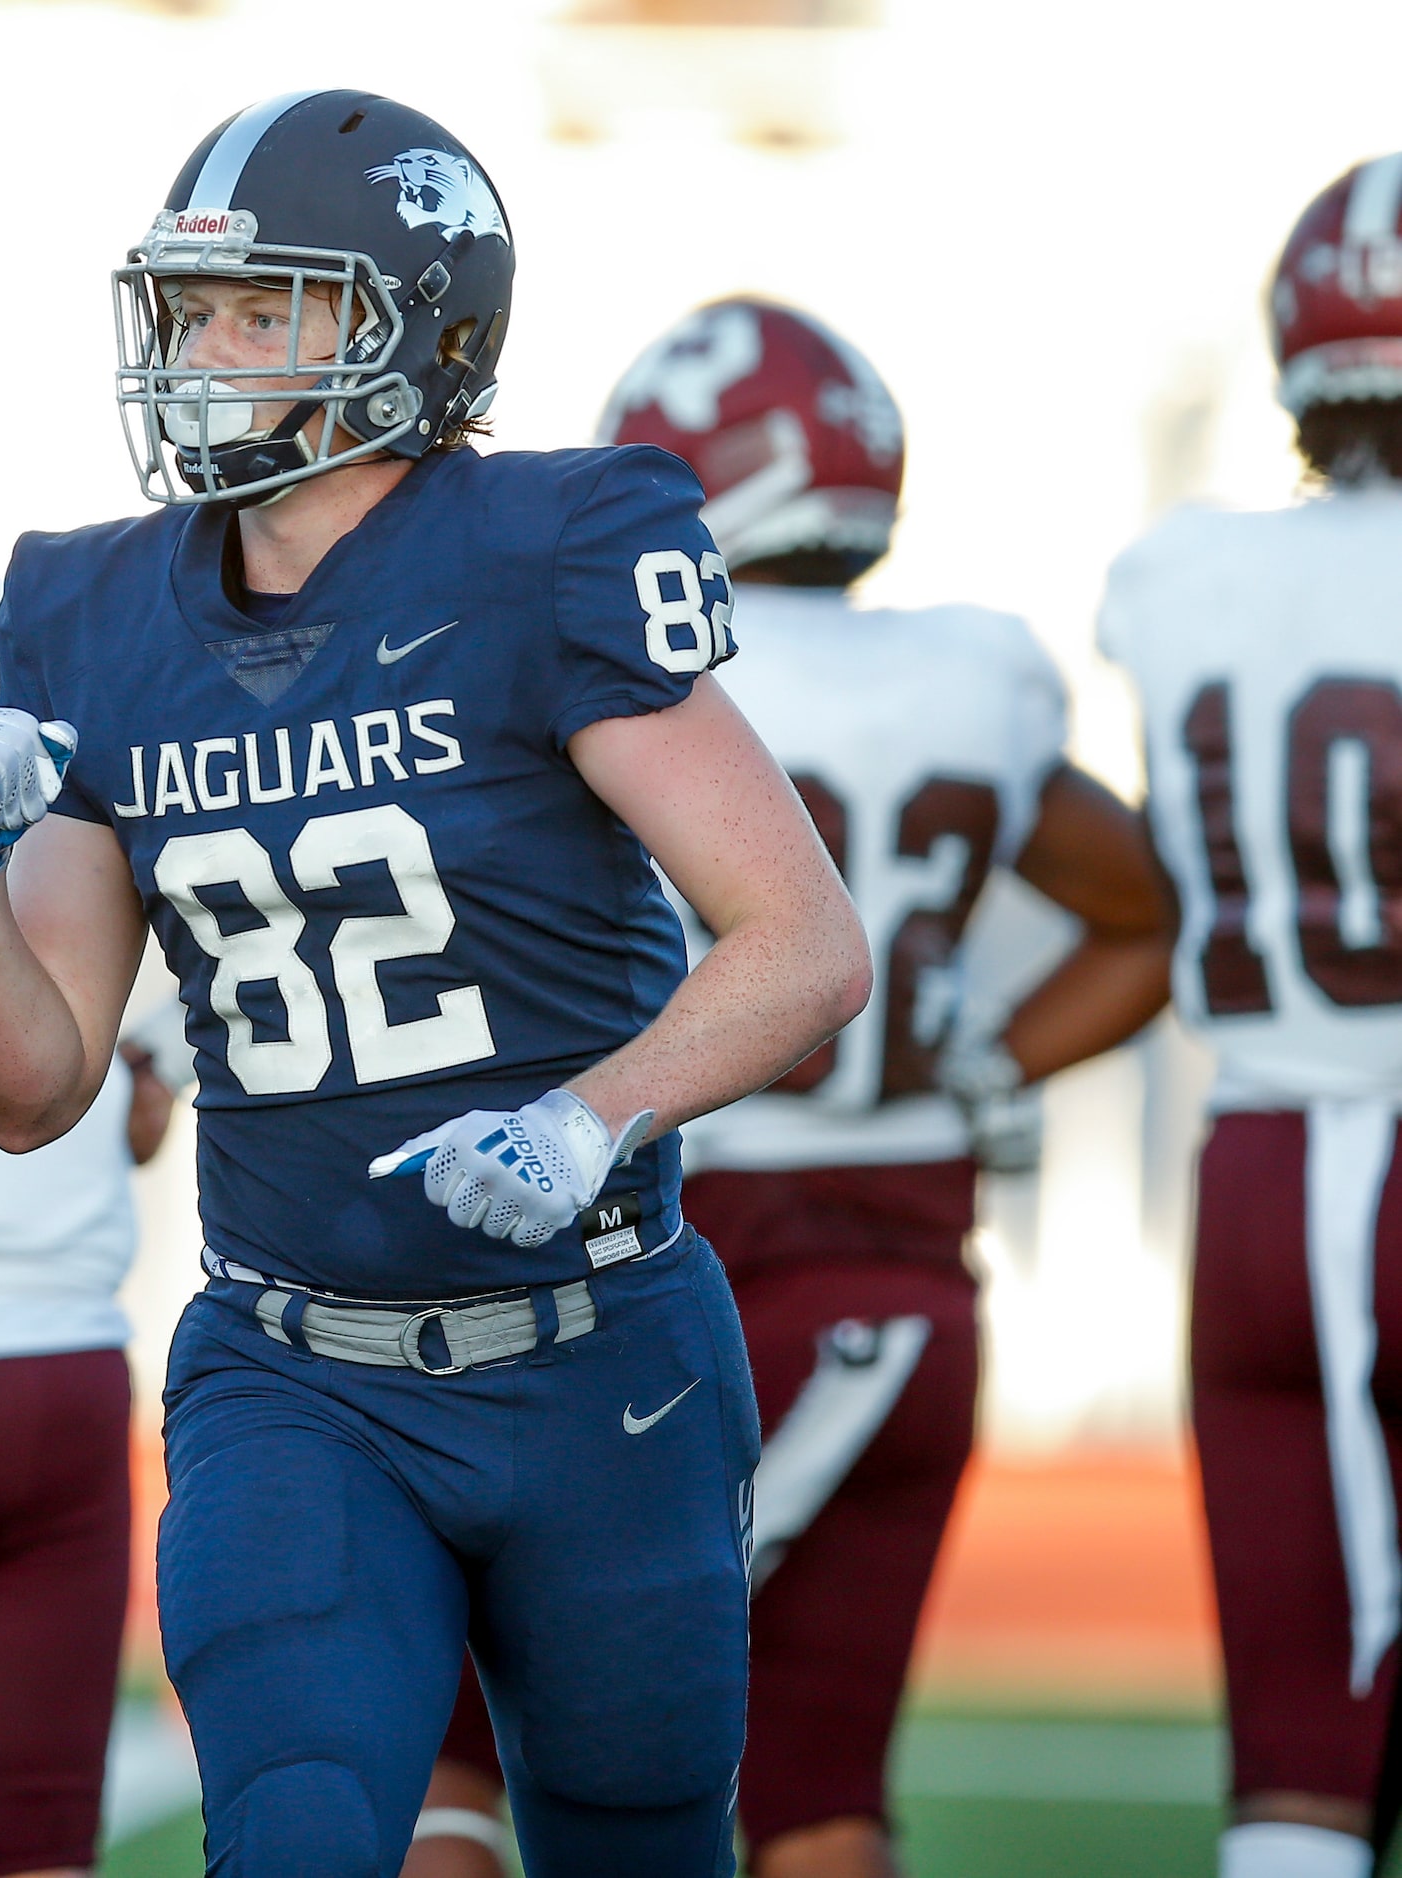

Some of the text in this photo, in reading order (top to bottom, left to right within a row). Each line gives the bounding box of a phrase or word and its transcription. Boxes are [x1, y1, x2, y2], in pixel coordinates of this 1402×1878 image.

[175, 214, 229, 234] Riddell
[113, 698, 466, 818] JAGUARS
[1182, 676, 1402, 1018] 10
[153, 803, 497, 1096] 82
[503, 1116, 554, 1194] adidas
[598, 1206, 623, 1230] M
